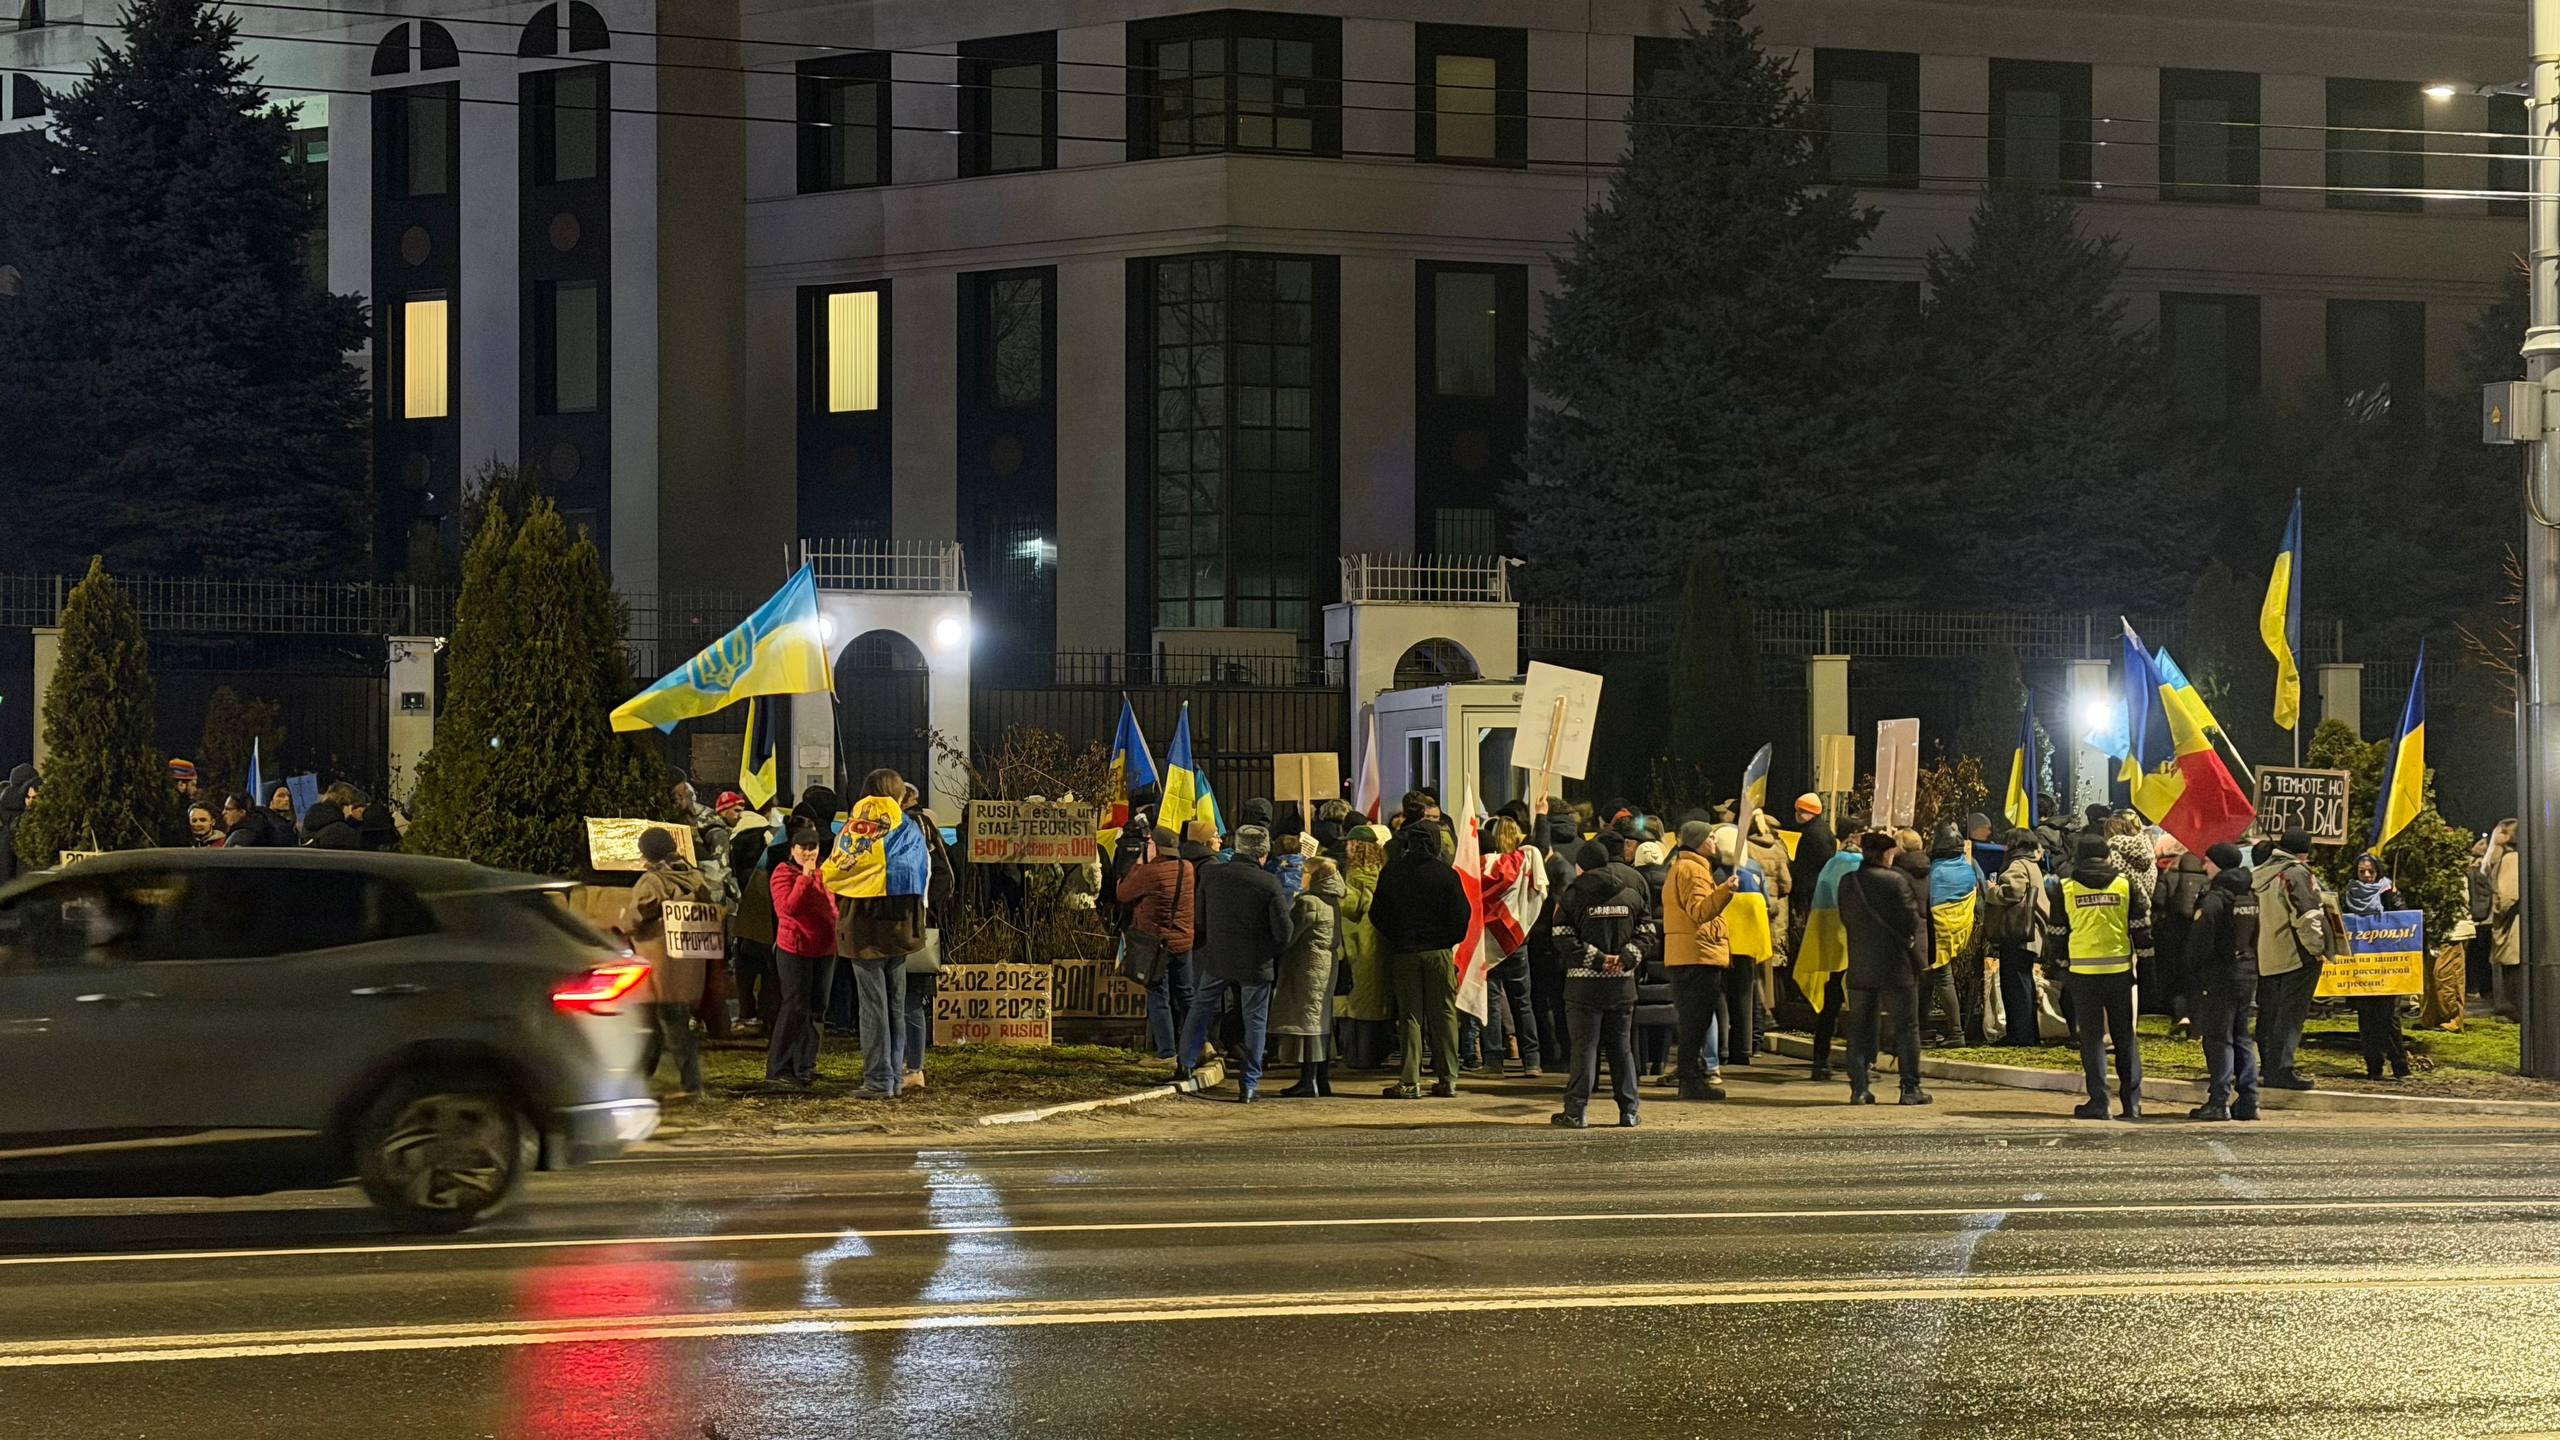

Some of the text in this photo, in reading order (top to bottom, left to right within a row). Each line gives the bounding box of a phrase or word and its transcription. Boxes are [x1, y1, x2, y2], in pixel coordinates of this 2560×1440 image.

[2263, 775, 2272, 792] В
[2328, 779, 2344, 796] НО
[1032, 807, 1067, 819] este
[1077, 807, 1095, 819] un
[2310, 797, 2344, 836] ВАС
[1071, 837, 1096, 857] ООН
[2355, 923, 2417, 944] героям!
[938, 970, 1047, 991] 24.02.2022
[937, 997, 1046, 1020] 24.02.2026
